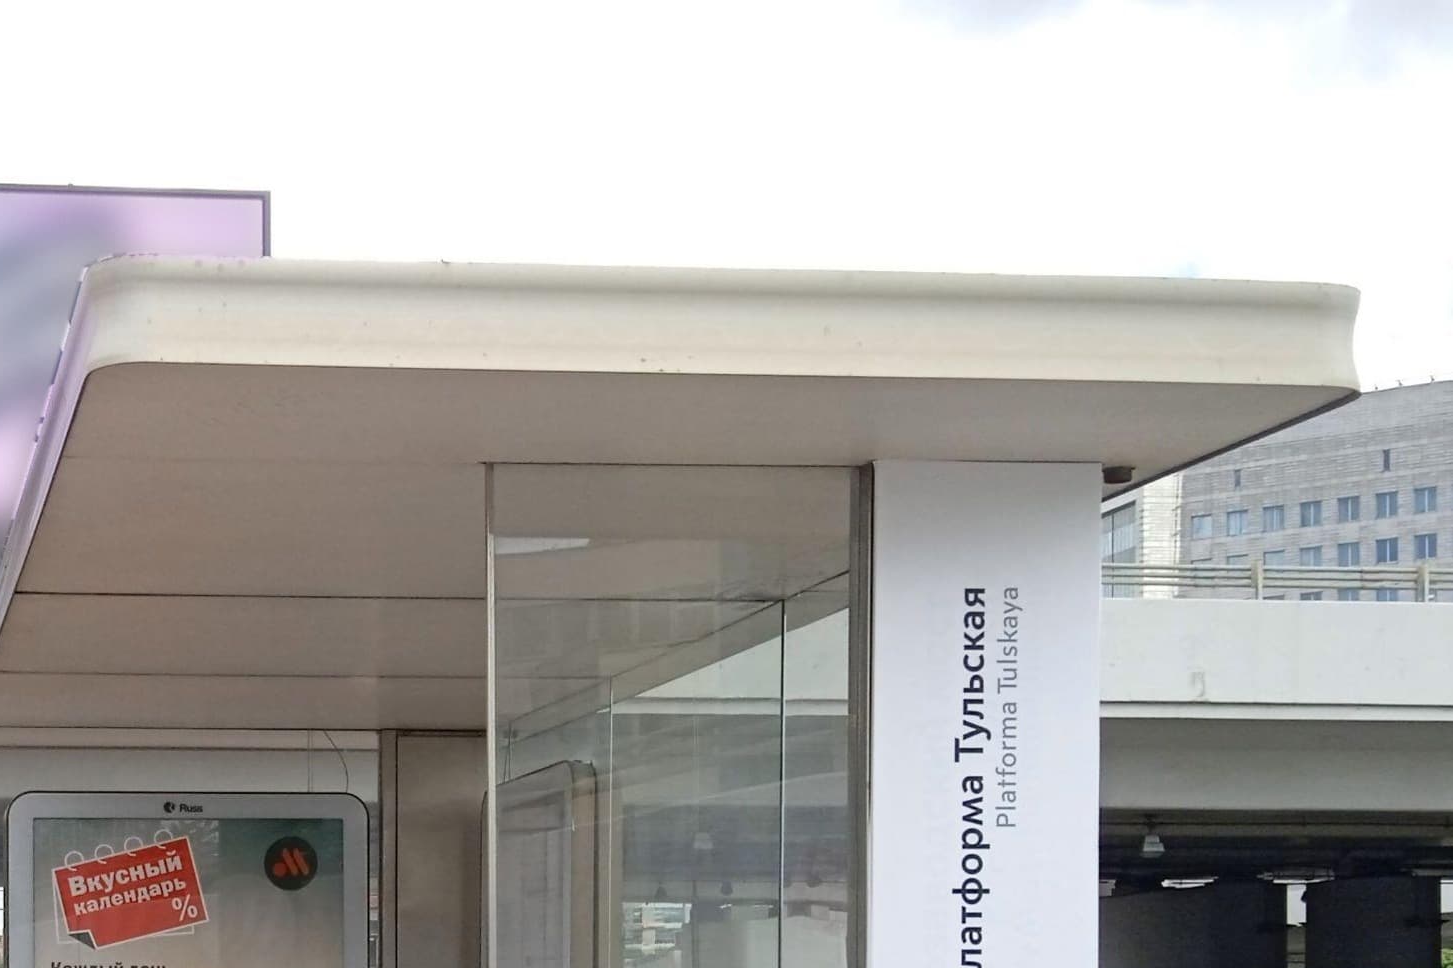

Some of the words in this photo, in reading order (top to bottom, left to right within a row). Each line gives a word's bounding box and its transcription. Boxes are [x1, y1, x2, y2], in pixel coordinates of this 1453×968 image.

[954, 587, 991, 763] Тульская
[996, 586, 1023, 694] Tulskaya
[995, 702, 1017, 828] Platforma
[67, 850, 183, 896] Вкусный
[73, 878, 187, 916] календарь
